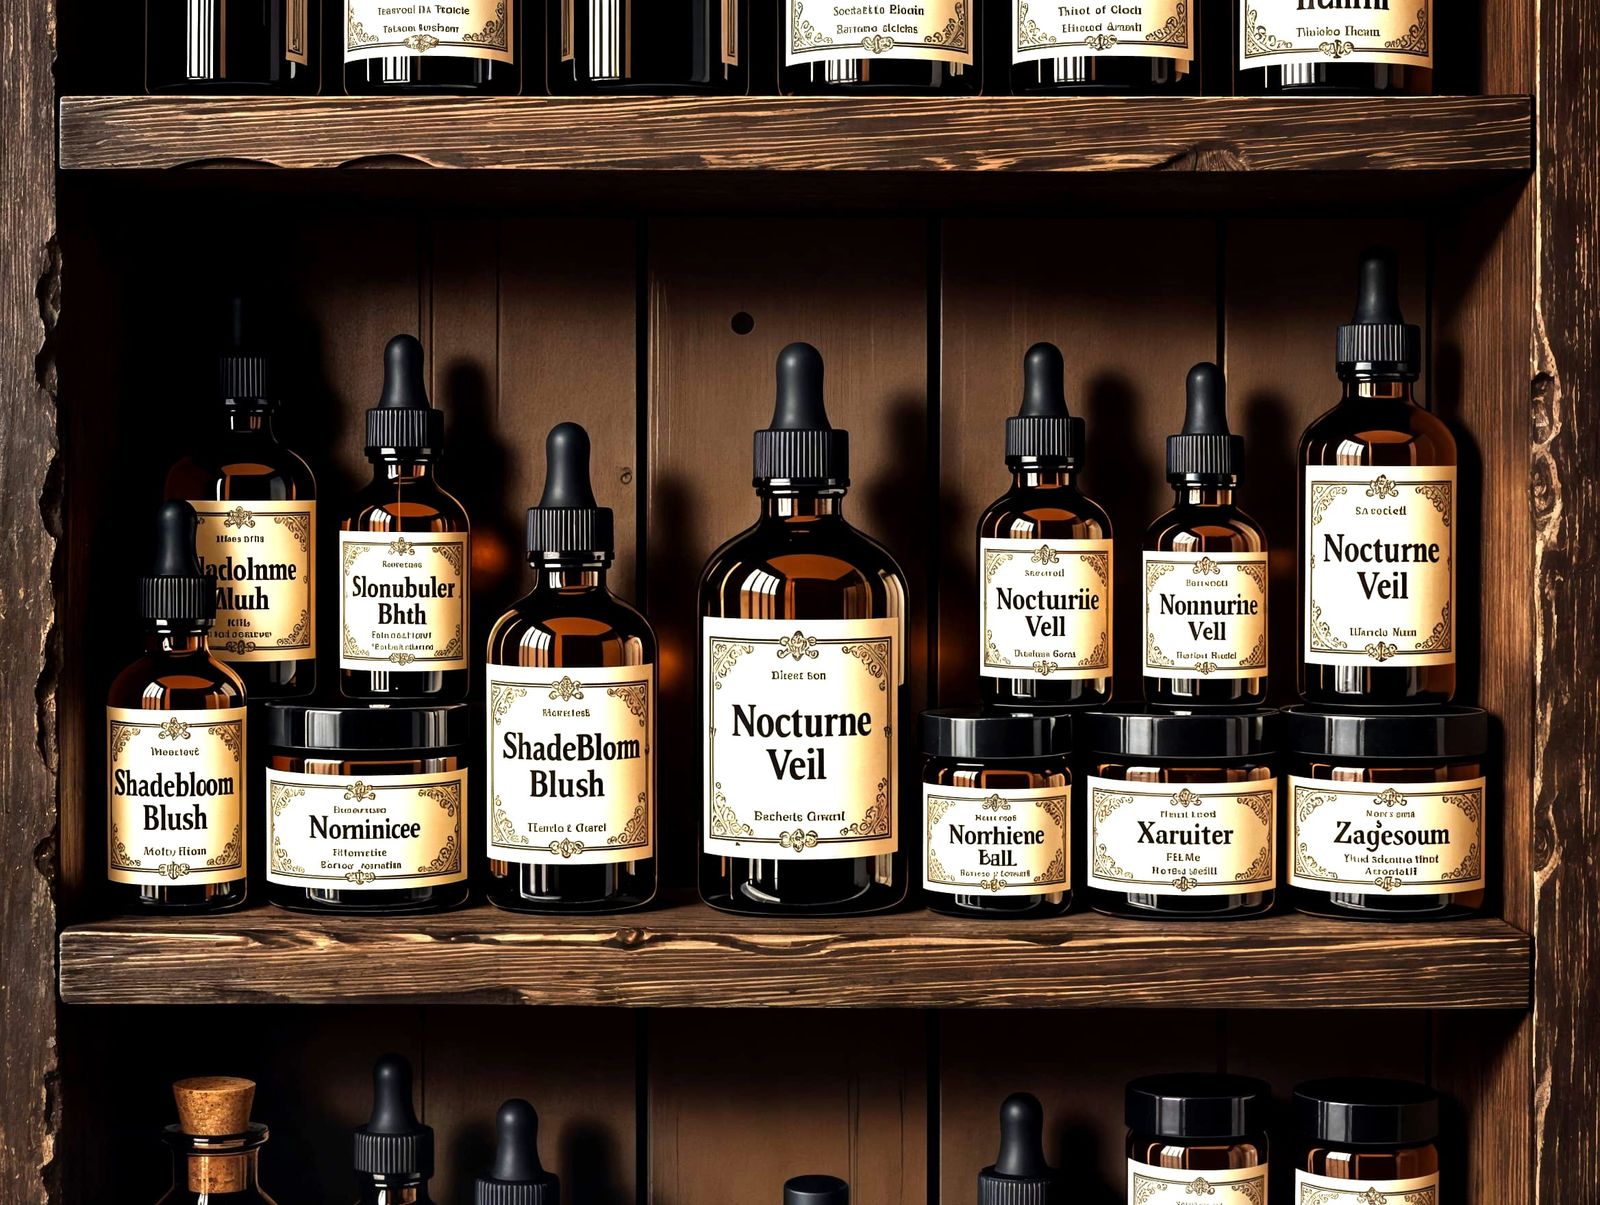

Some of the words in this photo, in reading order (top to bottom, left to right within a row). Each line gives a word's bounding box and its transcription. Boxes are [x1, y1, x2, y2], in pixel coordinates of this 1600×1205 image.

[1323, 533, 1440, 563] Nocturne
[352, 575, 456, 598] Slonubuler
[1357, 571, 1409, 600] Veil
[378, 602, 427, 625] Bhth
[1025, 615, 1066, 637] Vell
[1188, 621, 1227, 641] Vell
[732, 704, 872, 738] Nocturne
[766, 748, 827, 780] Veil
[114, 768, 234, 797] Shadebloom
[529, 769, 605, 798] Blush
[143, 804, 208, 830] Blush
[1137, 820, 1234, 845] Xaruiter
